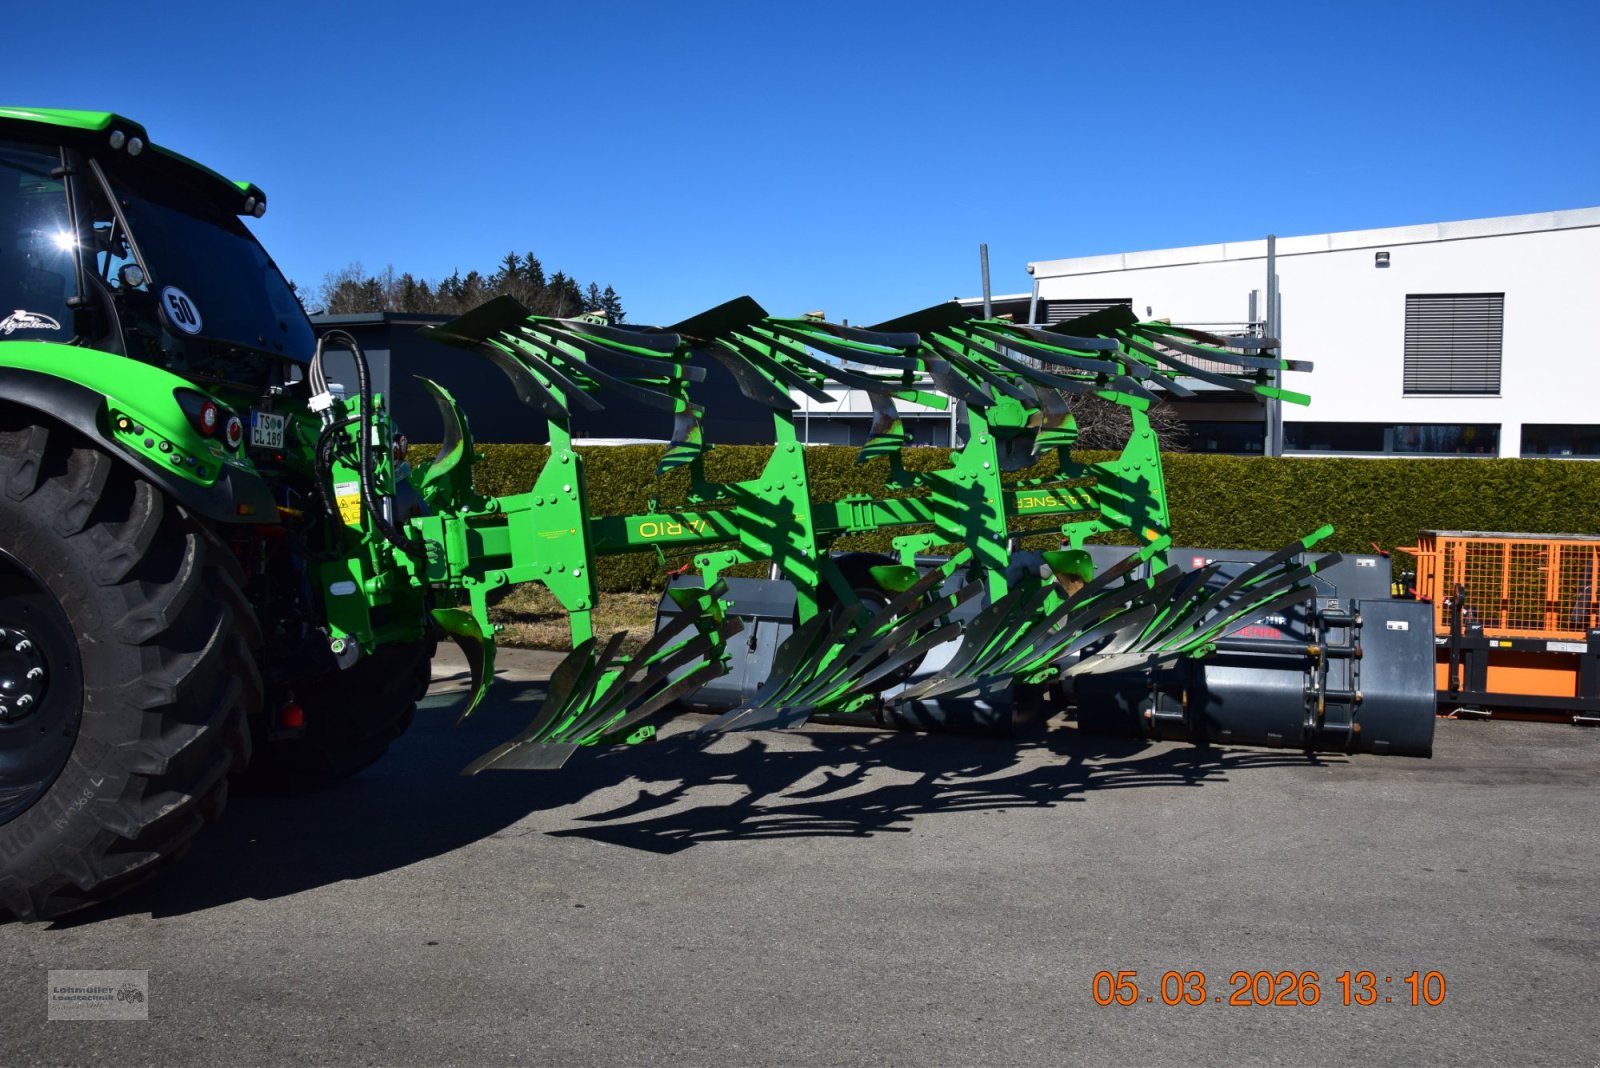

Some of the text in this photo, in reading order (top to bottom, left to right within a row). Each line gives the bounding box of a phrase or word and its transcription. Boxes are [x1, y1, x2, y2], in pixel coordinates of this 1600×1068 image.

[168, 294, 196, 326] 50
[260, 414, 271, 430] TS
[253, 429, 282, 447] CL 189
[639, 519, 715, 538] VARIO
